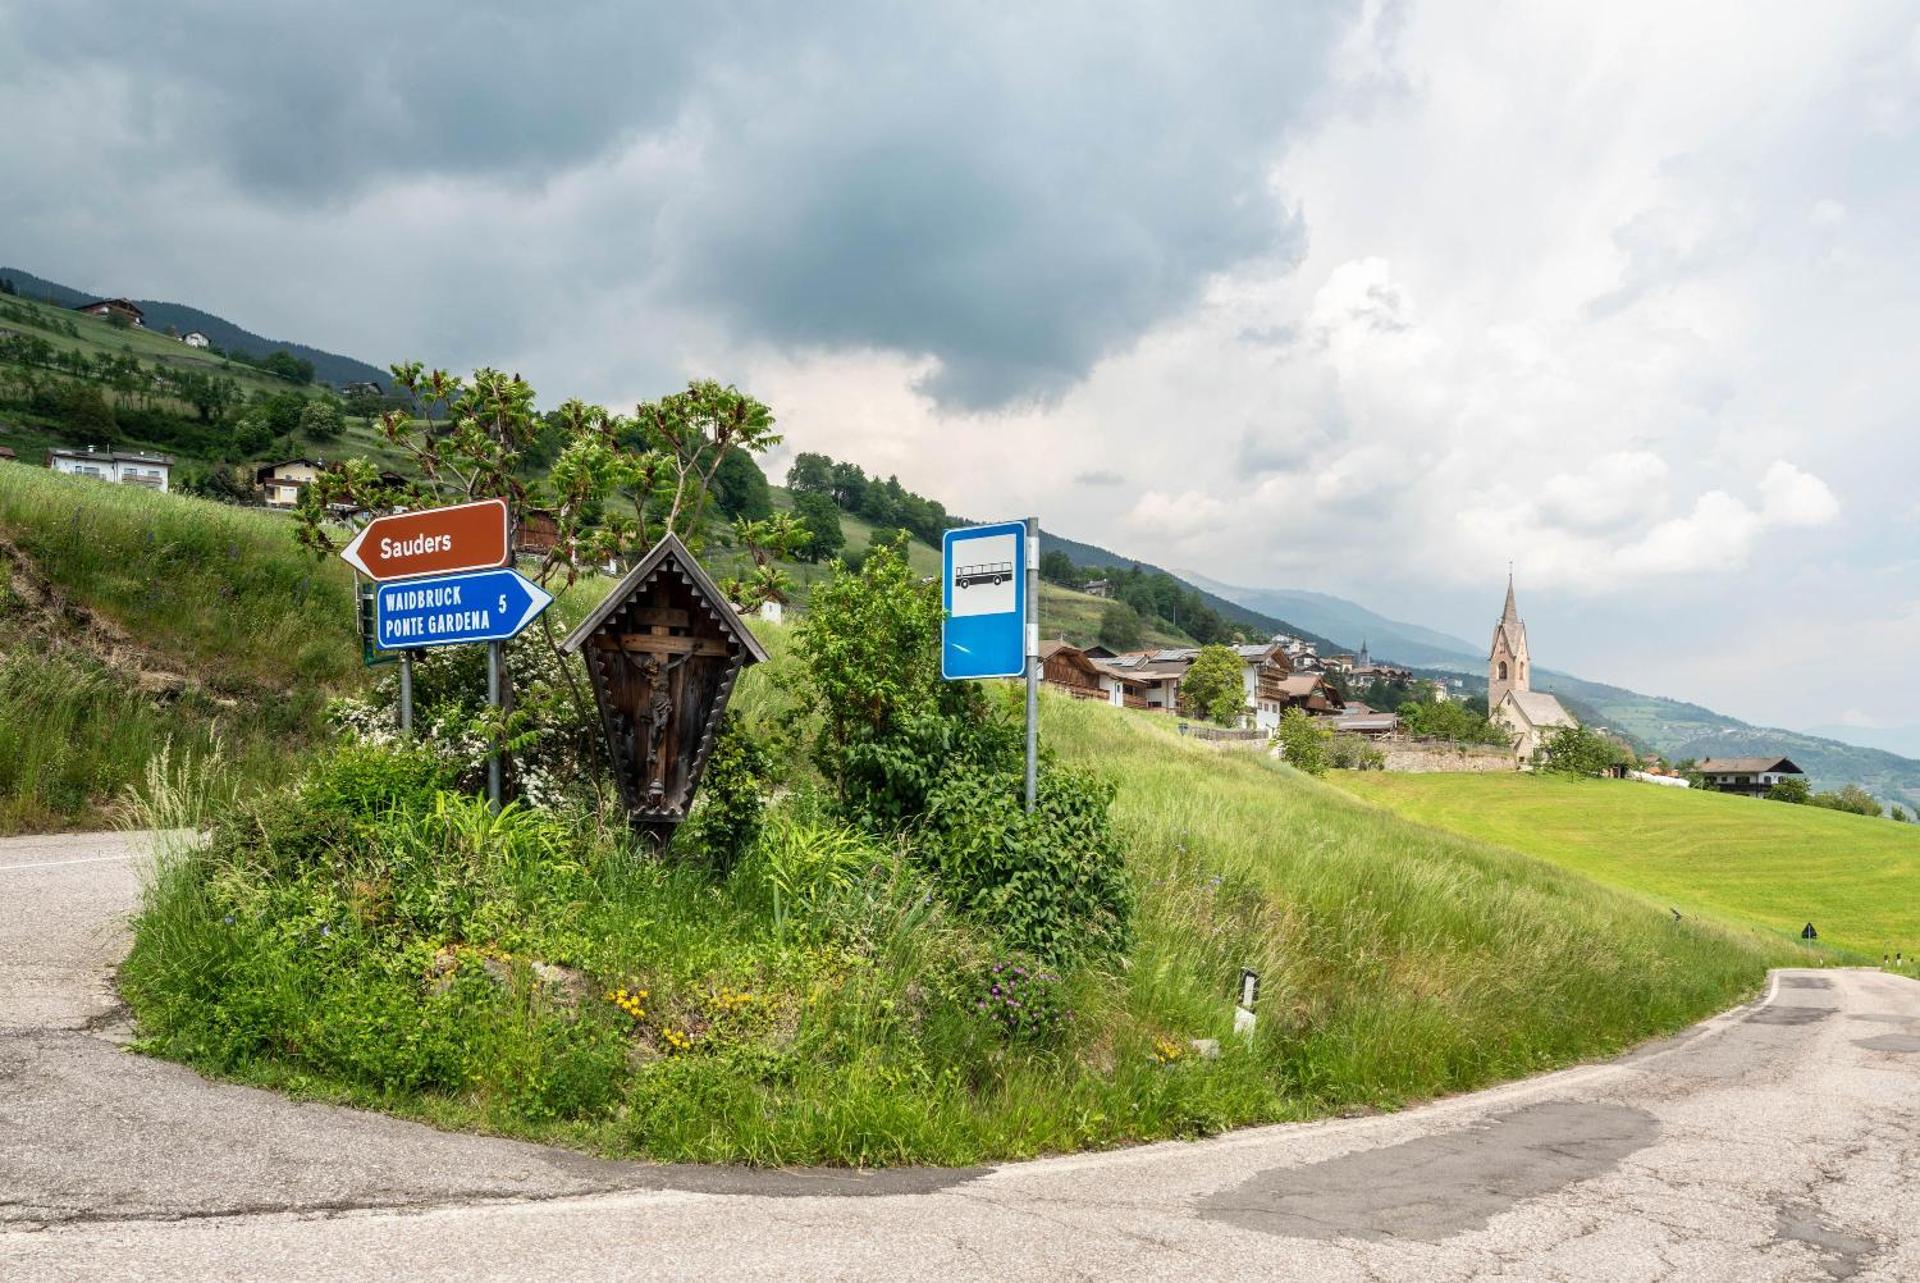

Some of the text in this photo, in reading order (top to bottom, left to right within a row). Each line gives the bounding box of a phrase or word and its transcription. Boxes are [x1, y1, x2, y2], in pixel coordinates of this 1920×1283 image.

[380, 533, 452, 559] Sauders
[386, 586, 462, 612] WAIDBRUCK
[498, 594, 507, 614] 5
[386, 610, 490, 638] PONTE GARDENA
